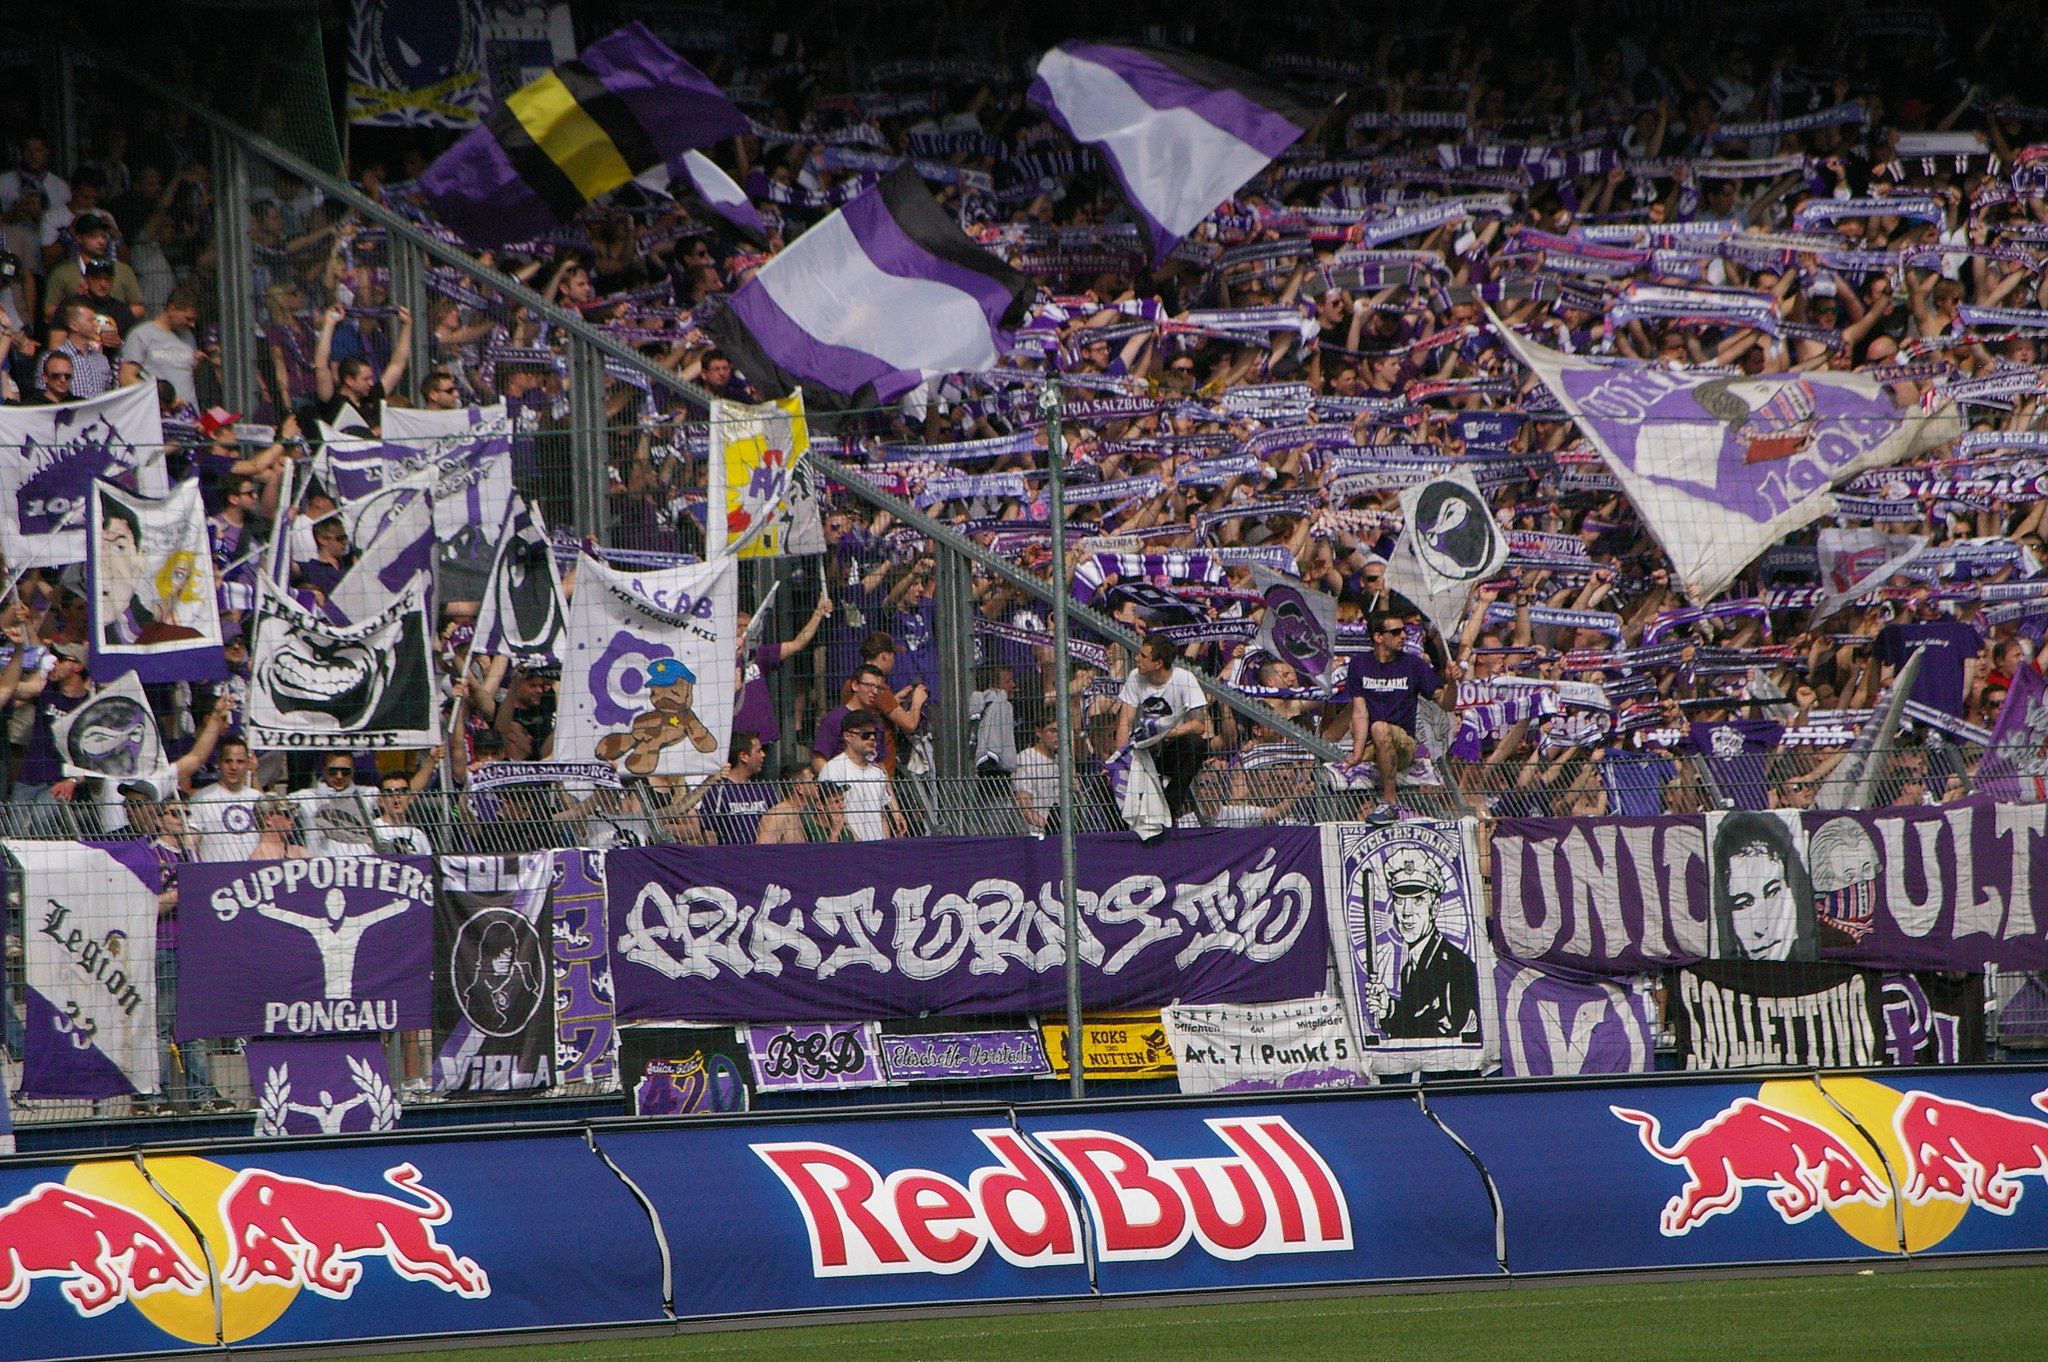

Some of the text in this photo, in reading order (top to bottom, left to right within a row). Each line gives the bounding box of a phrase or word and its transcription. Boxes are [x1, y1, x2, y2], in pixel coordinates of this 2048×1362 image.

[1685, 221, 1720, 234] BULL
[2003, 431, 2034, 444] RED
[1221, 547, 1247, 560] RED
[1251, 547, 1285, 562] BULL
[1362, 676, 1409, 690] VIOLET ARMY
[258, 731, 399, 748] VIOLETTE
[479, 764, 537, 782] AUSTRIA
[540, 763, 610, 780] SALZBURG
[1387, 825, 1413, 841] THE
[440, 850, 553, 892] SOLO
[210, 856, 435, 922] SUPPORTERS
[39, 897, 143, 1016] Legion
[264, 999, 398, 1034] PONGAU
[1296, 1016, 1344, 1031] Mitglieder
[1090, 1030, 1127, 1044] KOKS
[893, 1040, 1034, 1069] Elisabeth-Vorstadt
[1088, 1052, 1146, 1065] NUTTEN
[1185, 1044, 1225, 1065] Art.
[1229, 1044, 1242, 1065] 7
[1260, 1040, 1330, 1065] Punkt
[1334, 1038, 1348, 1060] 5
[756, 1117, 1350, 1273] Red Bull
